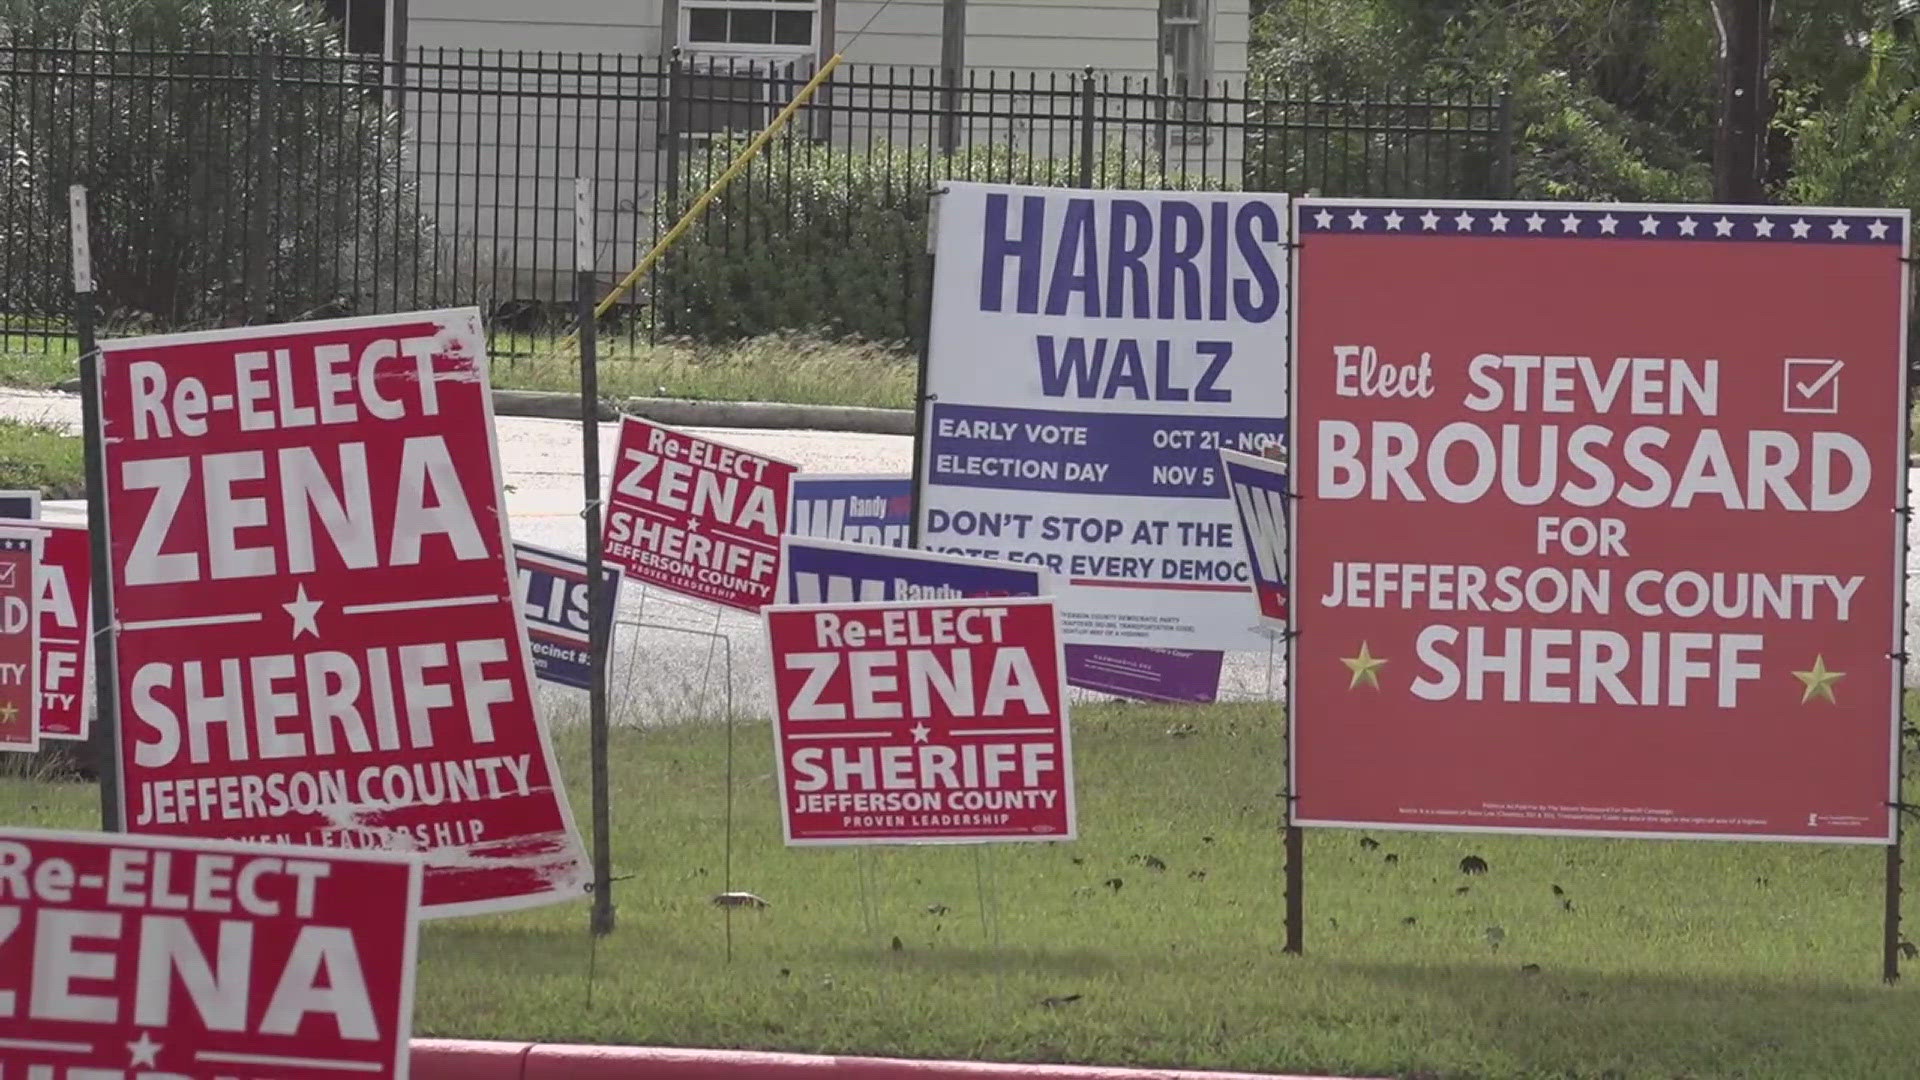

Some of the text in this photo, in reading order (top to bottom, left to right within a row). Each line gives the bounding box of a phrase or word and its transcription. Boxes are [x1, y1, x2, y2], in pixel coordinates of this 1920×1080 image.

[980, 193, 1281, 323] HARRIS
[129, 339, 445, 440] Re-ELECT
[1036, 335, 1233, 403] WALZ
[1333, 345, 1719, 416] Elect STEVEN
[648, 428, 770, 483] Re-ELECT
[938, 418, 1088, 446] EARLY VOTE
[1153, 430, 1195, 450] OCT
[1200, 431, 1220, 449] 21
[617, 448, 779, 537] ZENA
[936, 455, 1110, 483] ELECTION DAY
[1152, 466, 1215, 486] NOV 5
[1317, 420, 1872, 512] BROUSSARD
[121, 435, 490, 586] ZENA
[850, 495, 887, 520] Randy
[927, 508, 1033, 540] DON'T
[1041, 517, 1124, 545] STOP
[1132, 522, 1170, 547] AT
[1177, 522, 1233, 549] THE
[1537, 516, 1629, 557] FOR
[605, 541, 695, 577] JEFFERSON
[698, 568, 771, 599] COUNTY
[608, 511, 777, 582] SHERIFF
[1070, 555, 1155, 581] EVERY
[1160, 558, 1249, 583] DEMOC
[631, 563, 737, 600] PROVEN LEADERSHIP
[1321, 562, 1865, 620] JEFFERSON COUNTY
[815, 608, 1008, 649] Re-ELECT
[785, 647, 1050, 721] ZENA
[1410, 625, 1764, 708] SHERIFF
[131, 638, 513, 768] SHERIFF
[136, 754, 532, 826] JEFFERSON COUNTY
[792, 743, 1055, 792] SHERIFF
[795, 790, 1058, 814] JEFFERSON COUNTY
[843, 813, 1010, 828] PROVEN LEADERSHIP
[0, 842, 331, 918] Re-ELECT
[0, 906, 380, 1042] ENA
